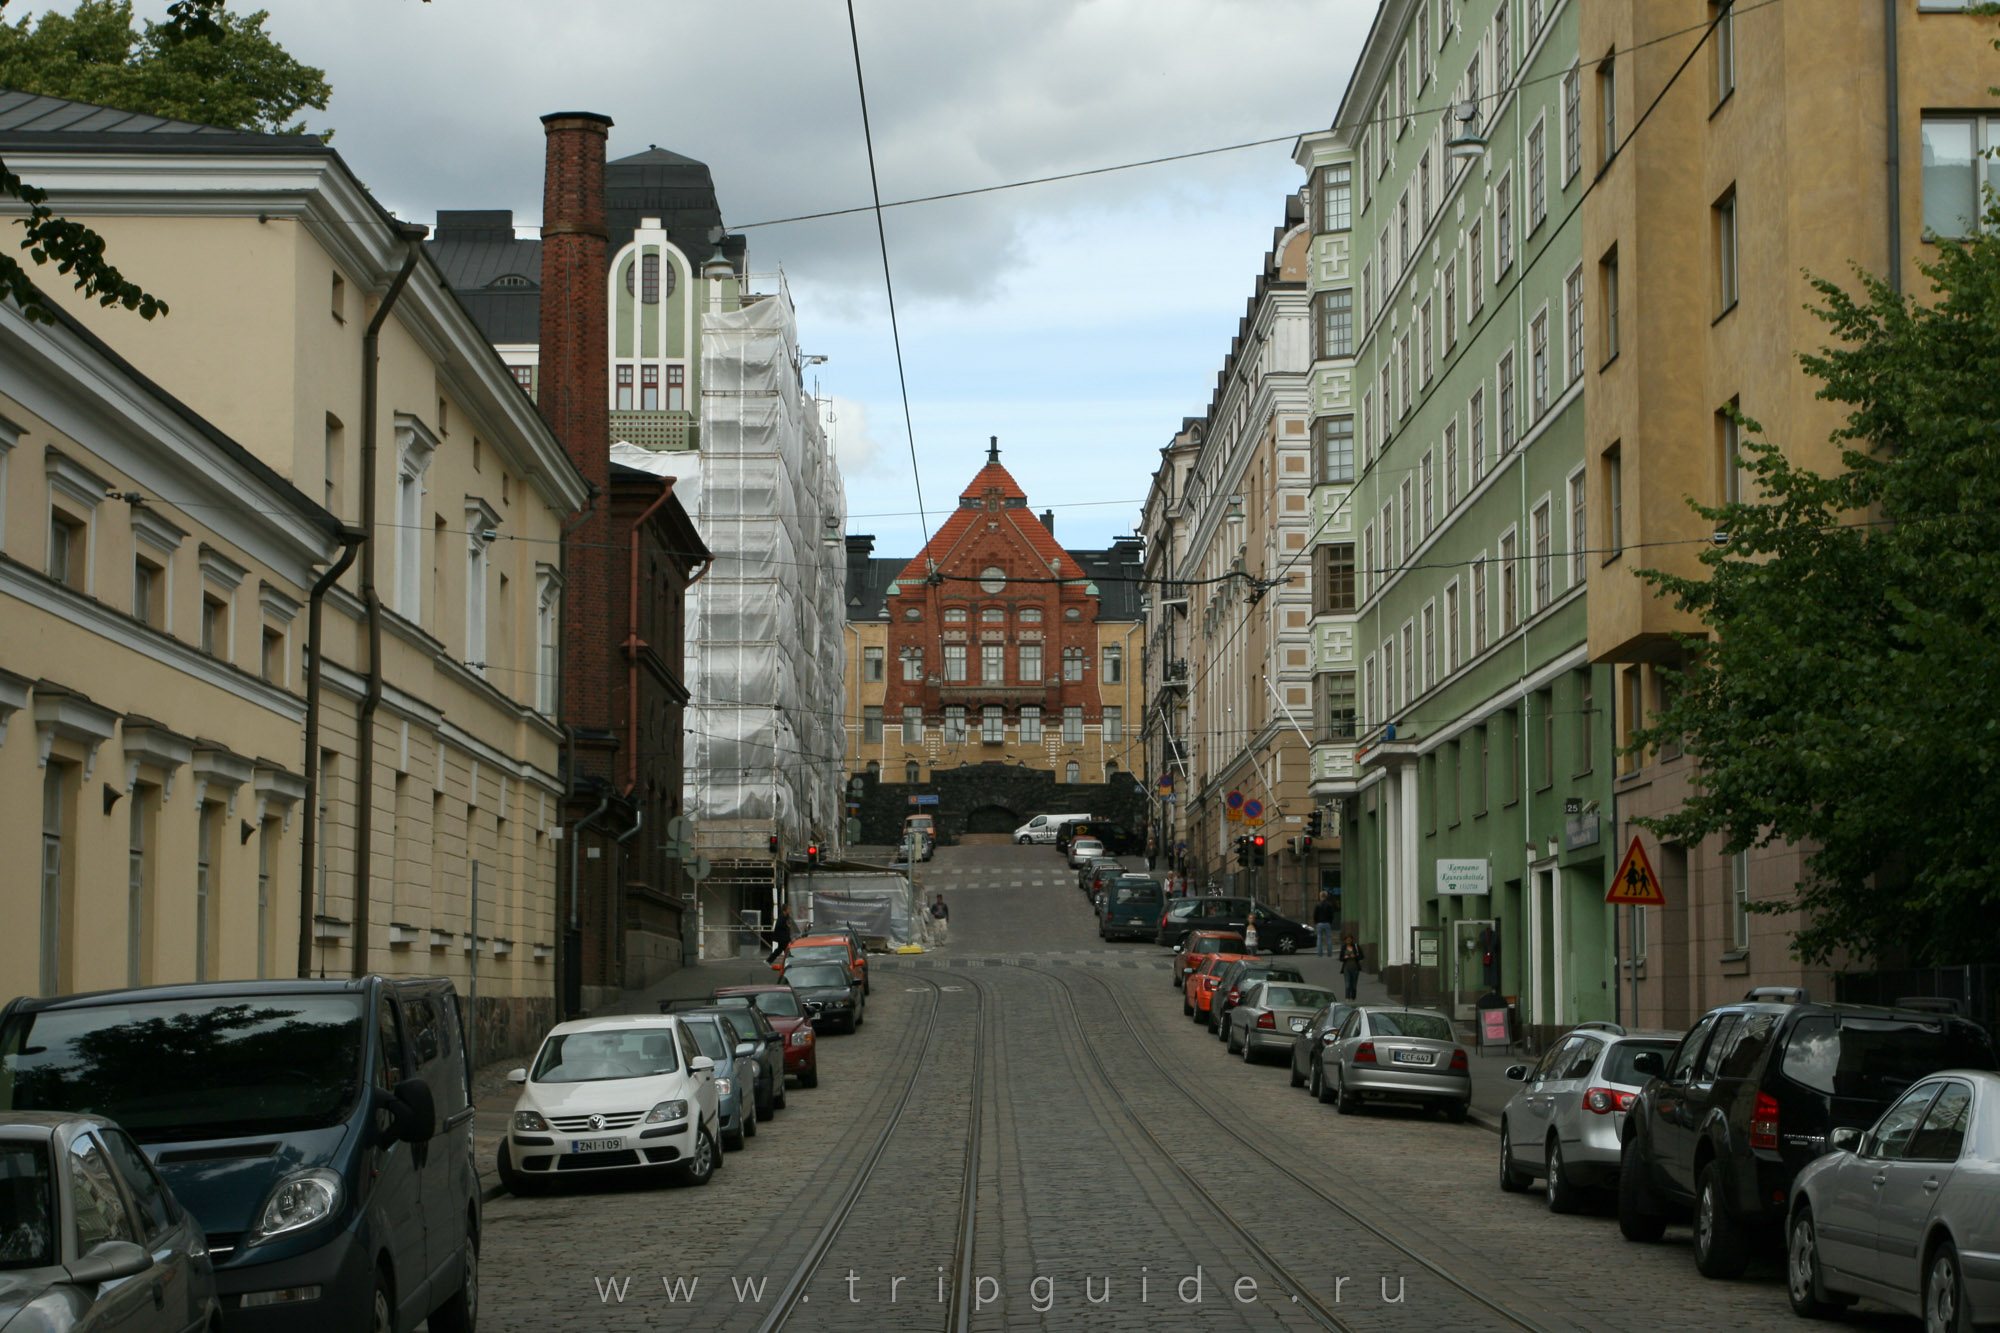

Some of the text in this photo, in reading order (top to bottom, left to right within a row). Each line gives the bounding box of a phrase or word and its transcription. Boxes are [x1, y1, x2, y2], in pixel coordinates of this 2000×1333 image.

[1567, 804, 1578, 812] 25
[1448, 863, 1480, 873] Kampaamo
[580, 1140, 620, 1151] ZNI-109
